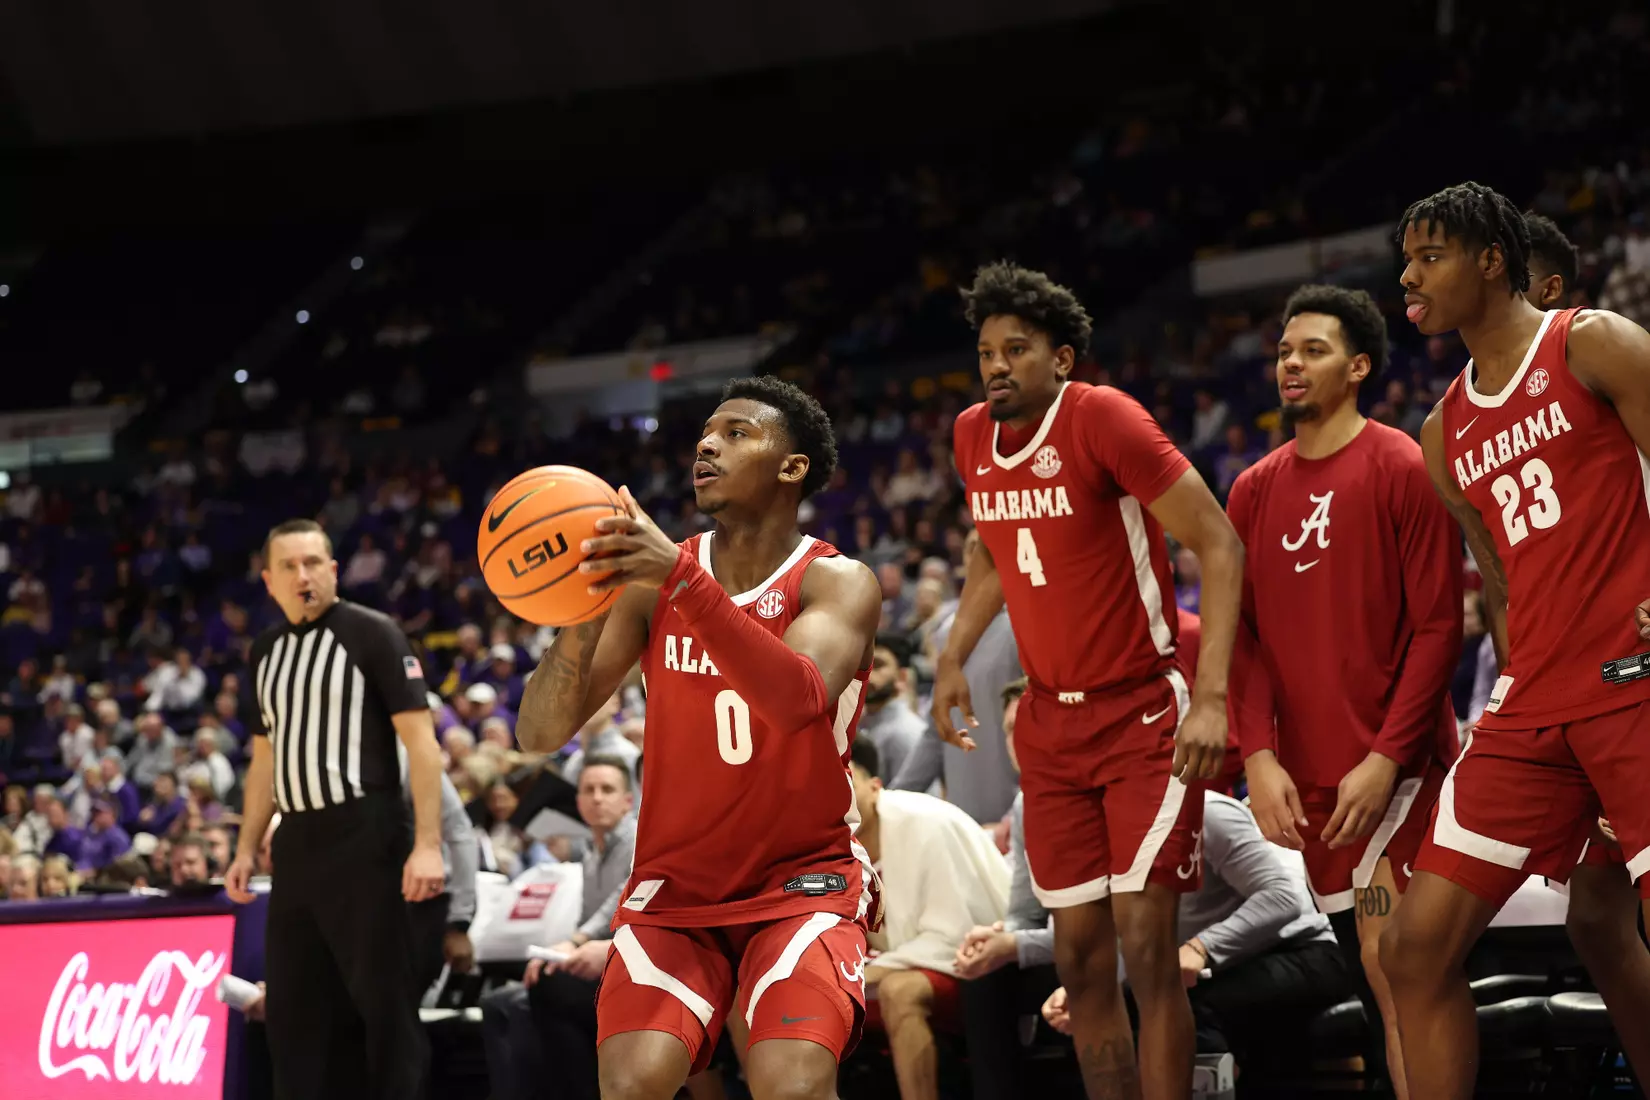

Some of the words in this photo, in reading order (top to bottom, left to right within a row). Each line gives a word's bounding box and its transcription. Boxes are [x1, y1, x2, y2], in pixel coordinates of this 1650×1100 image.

[1528, 370, 1548, 395] SEC
[1036, 447, 1057, 470] SEC
[1454, 400, 1573, 491] ALABAMA
[972, 486, 1073, 521] ALABAMA
[1281, 490, 1334, 551] A
[1491, 457, 1562, 547] 23
[507, 532, 568, 578] LSU
[1016, 527, 1047, 587] 4
[759, 591, 783, 616] SEC
[664, 634, 722, 676] ALA
[714, 689, 753, 765] 0
